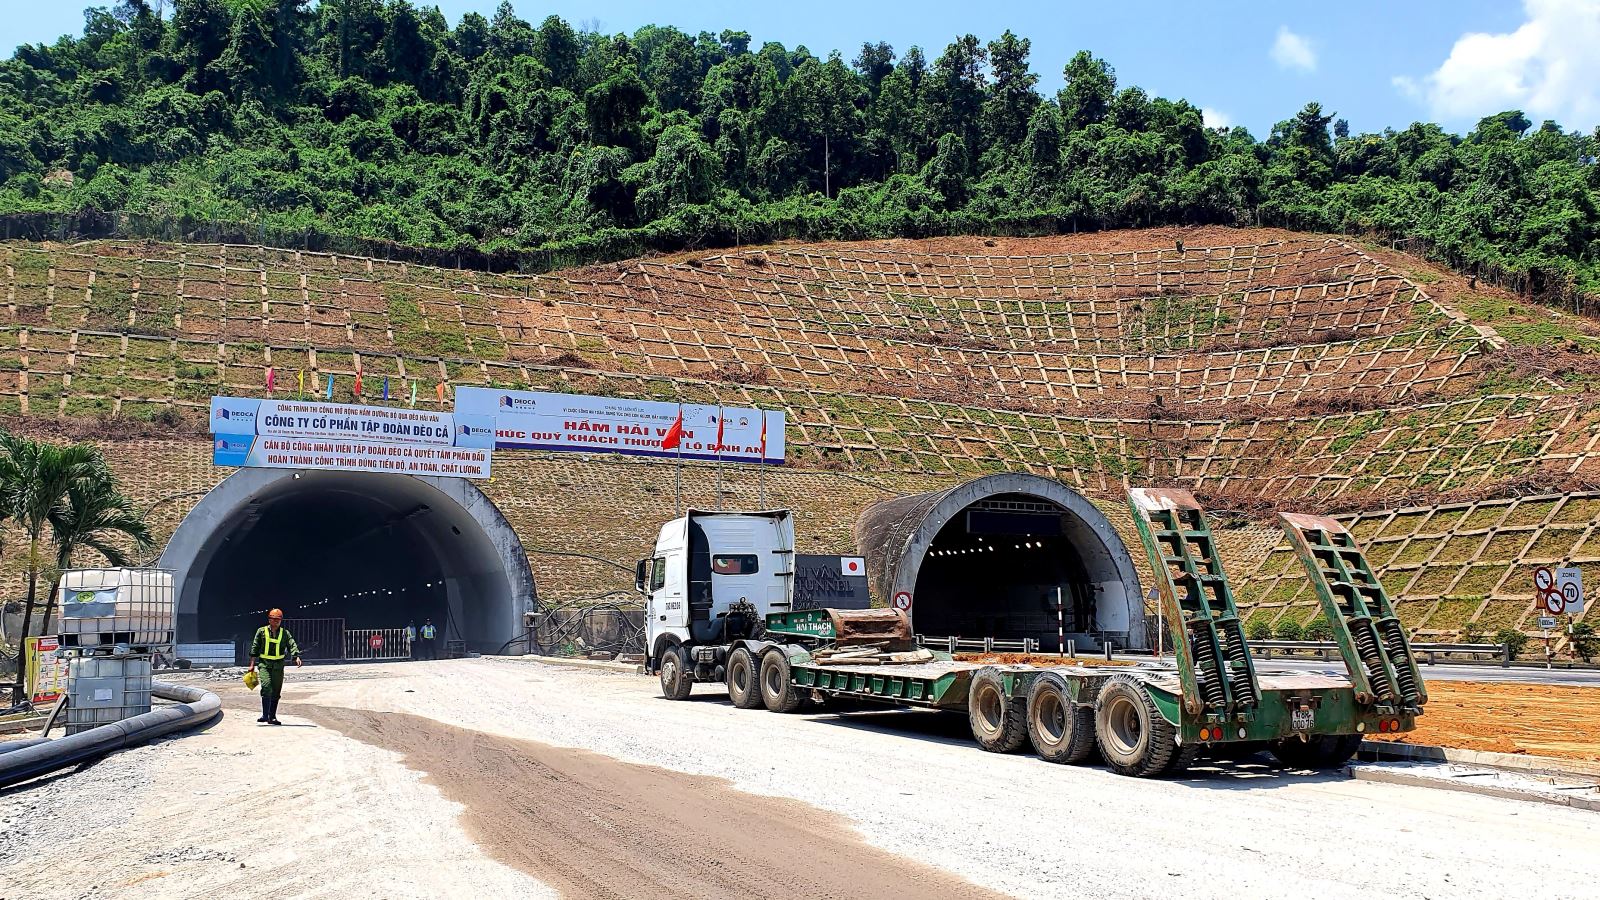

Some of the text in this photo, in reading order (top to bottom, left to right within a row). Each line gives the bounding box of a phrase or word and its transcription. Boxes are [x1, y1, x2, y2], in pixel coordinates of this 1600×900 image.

[265, 414, 294, 428] CÔNG
[297, 417, 311, 428] TY
[312, 415, 328, 429] CỔ
[361, 419, 380, 434] TẬP
[383, 422, 410, 436] ĐOÀN
[413, 424, 433, 437] ĐÈO
[435, 424, 449, 438] CẢ
[656, 426, 694, 439] VN
[264, 440, 279, 450] CÁN
[281, 440, 291, 452] BỘ
[292, 441, 312, 452] CÔNG
[313, 442, 334, 453] NHÂN
[335, 443, 352, 454] VIÊN
[353, 444, 367, 456] TẬP
[368, 445, 387, 456] ĐOÀN
[495, 429, 526, 439] HÚC
[531, 431, 562, 441] QUÝ
[567, 433, 618, 444] KHÁCH
[685, 442, 703, 451] LỘ
[706, 443, 741, 453] BNH
[744, 446, 762, 454] AN
[268, 453, 288, 464] HOÀN
[289, 454, 313, 465] THÀNH
[314, 455, 334, 466] CÔNG
[336, 456, 357, 467] TRÌNH
[379, 458, 394, 469] TIẾN
[408, 462, 419, 471] AN
[441, 463, 458, 473] CHẤT
[797, 580, 854, 592] TUNNEL
[1564, 588, 1575, 597] 70
